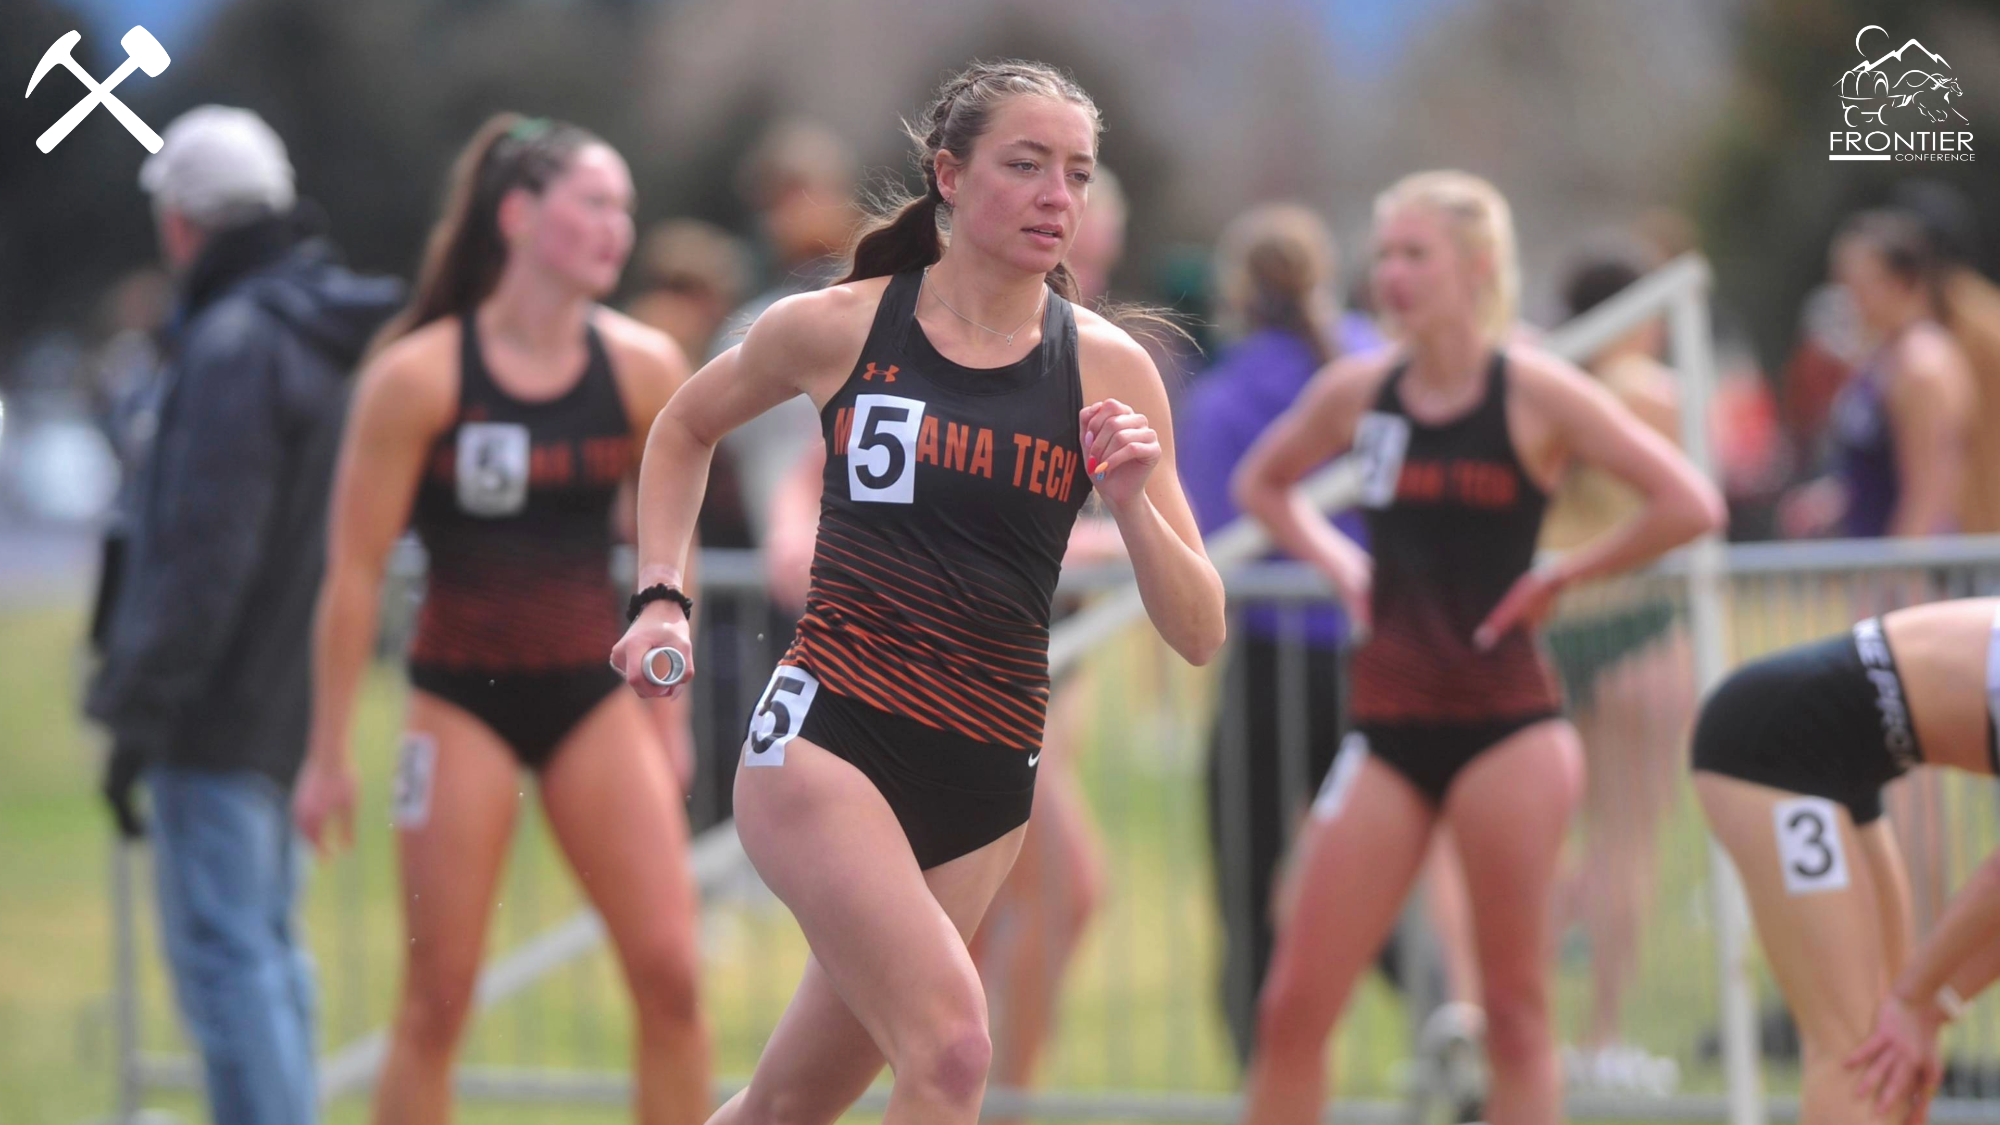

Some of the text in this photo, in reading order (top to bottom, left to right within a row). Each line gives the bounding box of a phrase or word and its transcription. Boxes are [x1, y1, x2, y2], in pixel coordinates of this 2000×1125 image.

[834, 406, 1078, 503] MANA TECH
[855, 405, 909, 490] 5
[751, 676, 806, 754] 5
[1788, 811, 1834, 879] 3
